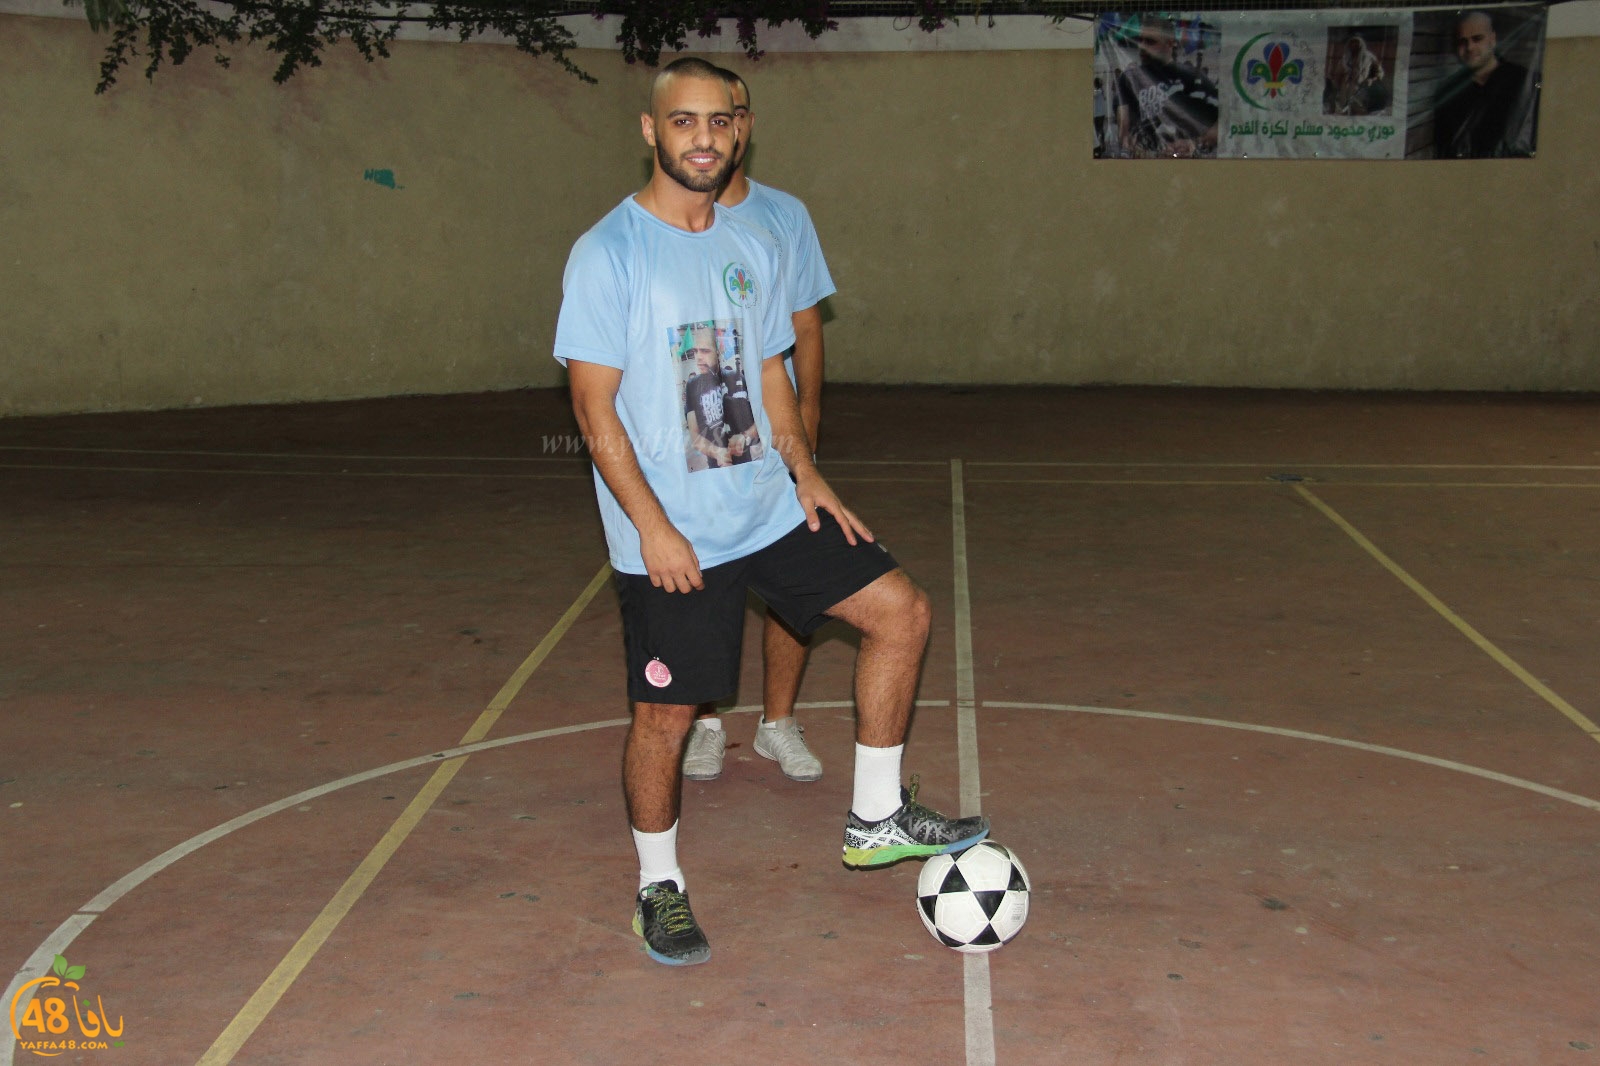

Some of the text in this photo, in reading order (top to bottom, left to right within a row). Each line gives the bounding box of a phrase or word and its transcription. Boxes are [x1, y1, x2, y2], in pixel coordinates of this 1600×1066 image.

[1228, 120, 1395, 142] دوري محمود مسلم لكرة القدم
